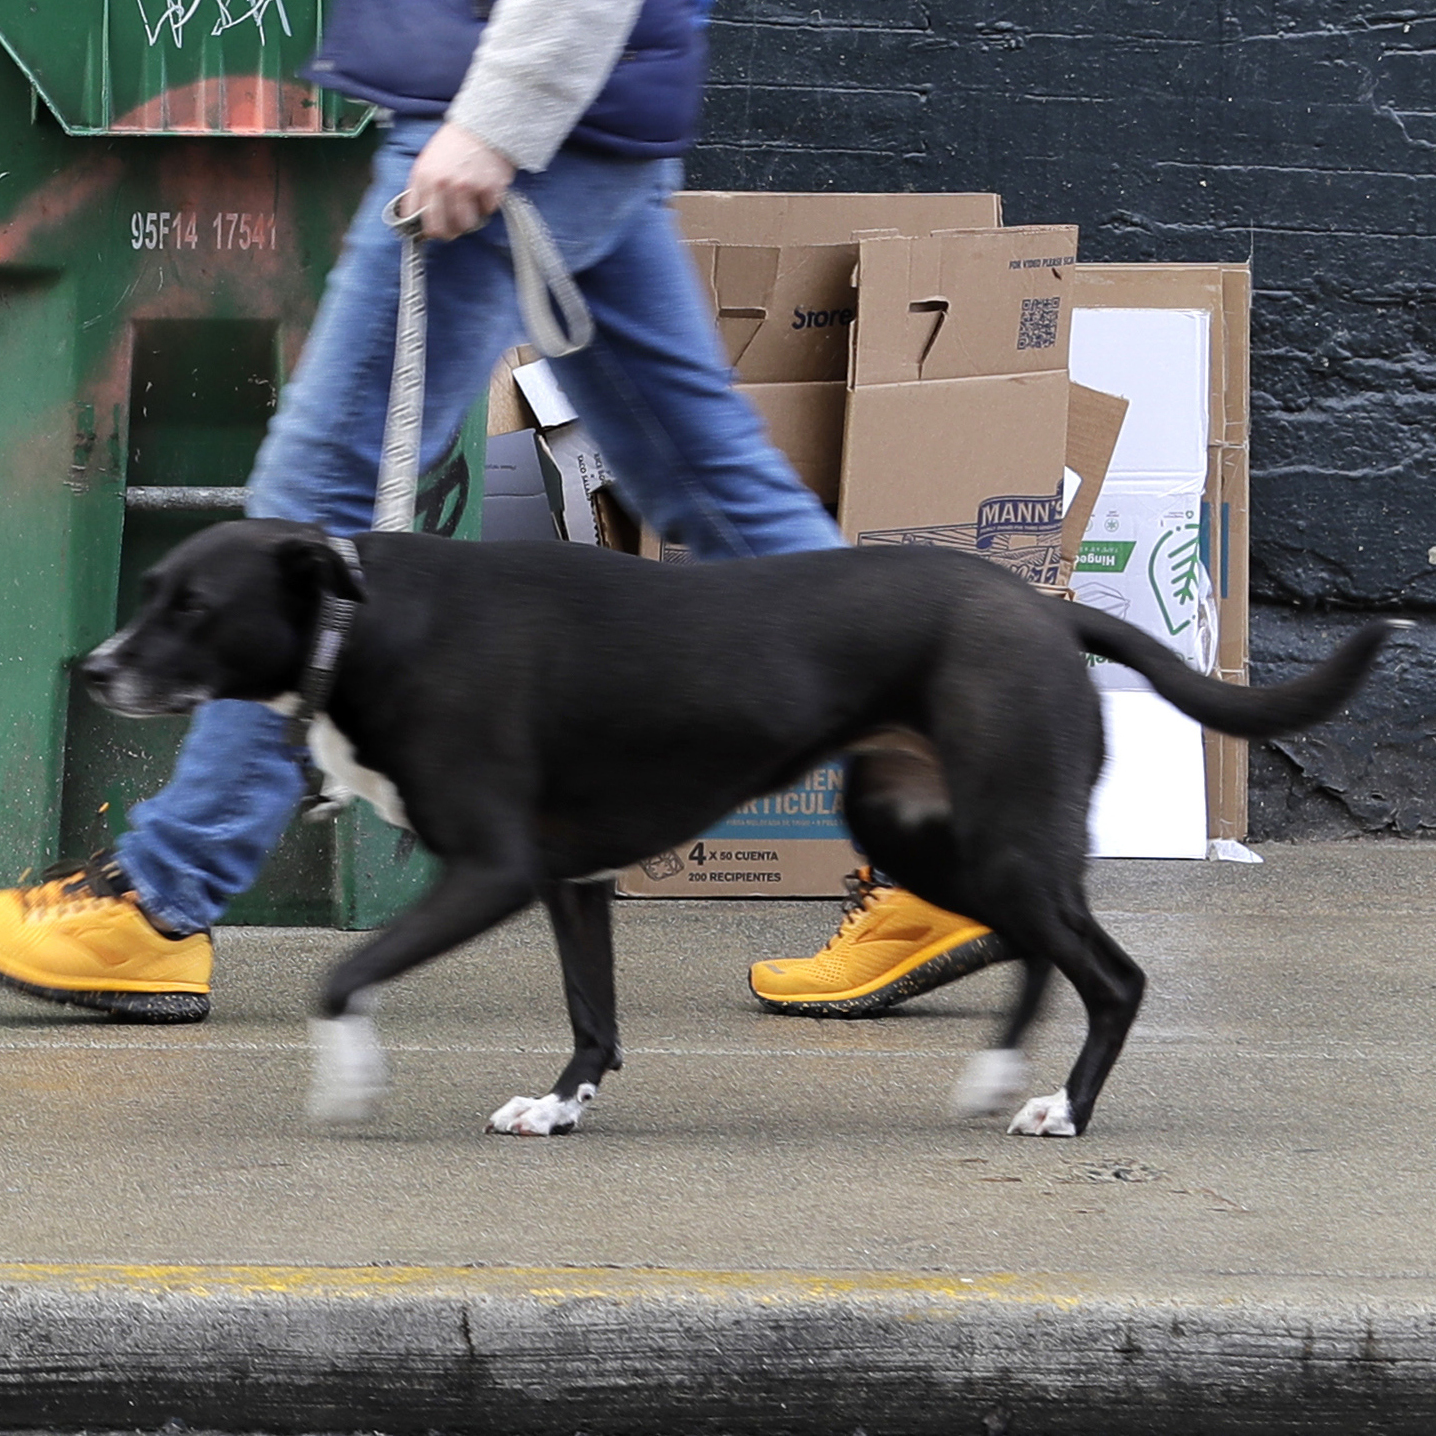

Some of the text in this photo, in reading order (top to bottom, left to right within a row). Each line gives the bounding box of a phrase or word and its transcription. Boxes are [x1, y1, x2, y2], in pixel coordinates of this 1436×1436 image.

[130, 211, 277, 251] 95F14 17541
[791, 304, 854, 330] Store
[688, 842, 707, 866] 4
[719, 850, 733, 861] 50
[734, 850, 779, 861] CUENTA
[688, 872, 782, 882] 200 RECIPIENTES
